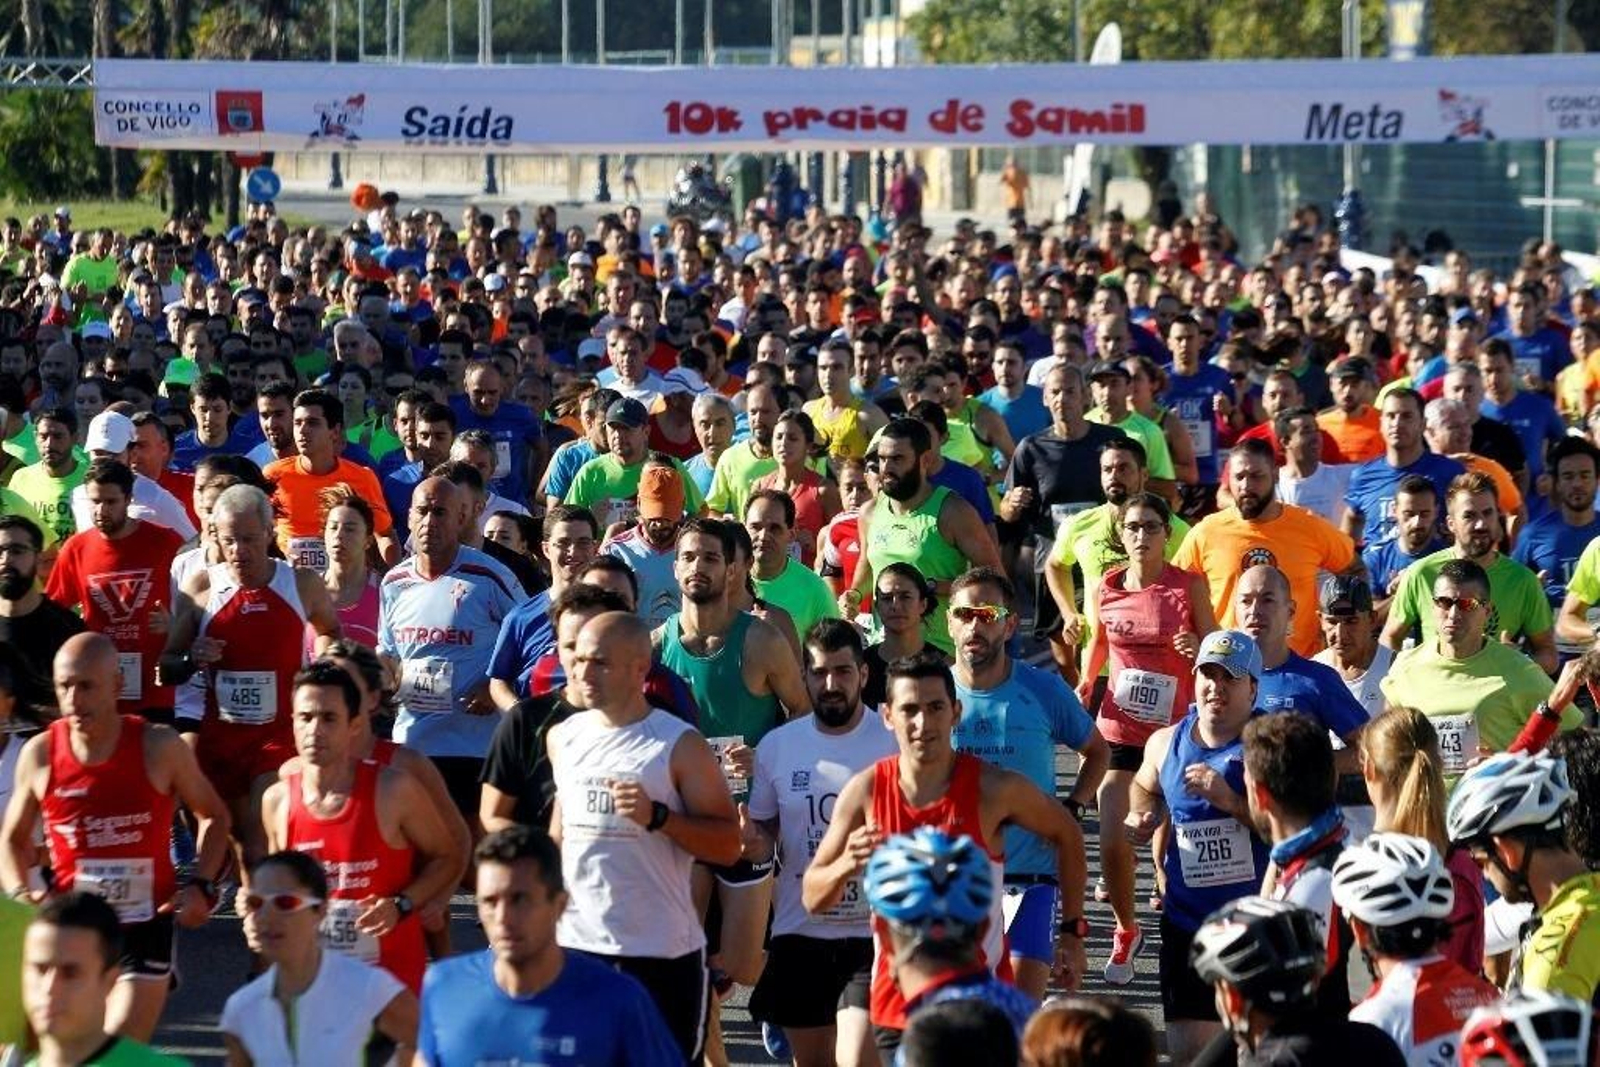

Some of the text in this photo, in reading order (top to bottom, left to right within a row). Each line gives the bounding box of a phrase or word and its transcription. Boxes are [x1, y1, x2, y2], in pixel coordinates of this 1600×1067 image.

[104, 101, 201, 115] CONCELLO
[117, 115, 191, 132] DE VIGO
[401, 105, 514, 141] Saída
[763, 106, 908, 137] praia
[928, 99, 985, 134] de
[1005, 99, 1146, 138] Samil
[1304, 103, 1403, 141] Meta
[1558, 114, 1580, 129] DE
[300, 550, 326, 566] 605
[231, 687, 262, 706] 485
[1128, 685, 1160, 706] 1190
[1441, 732, 1462, 752] 43
[1195, 838, 1232, 863] 266
